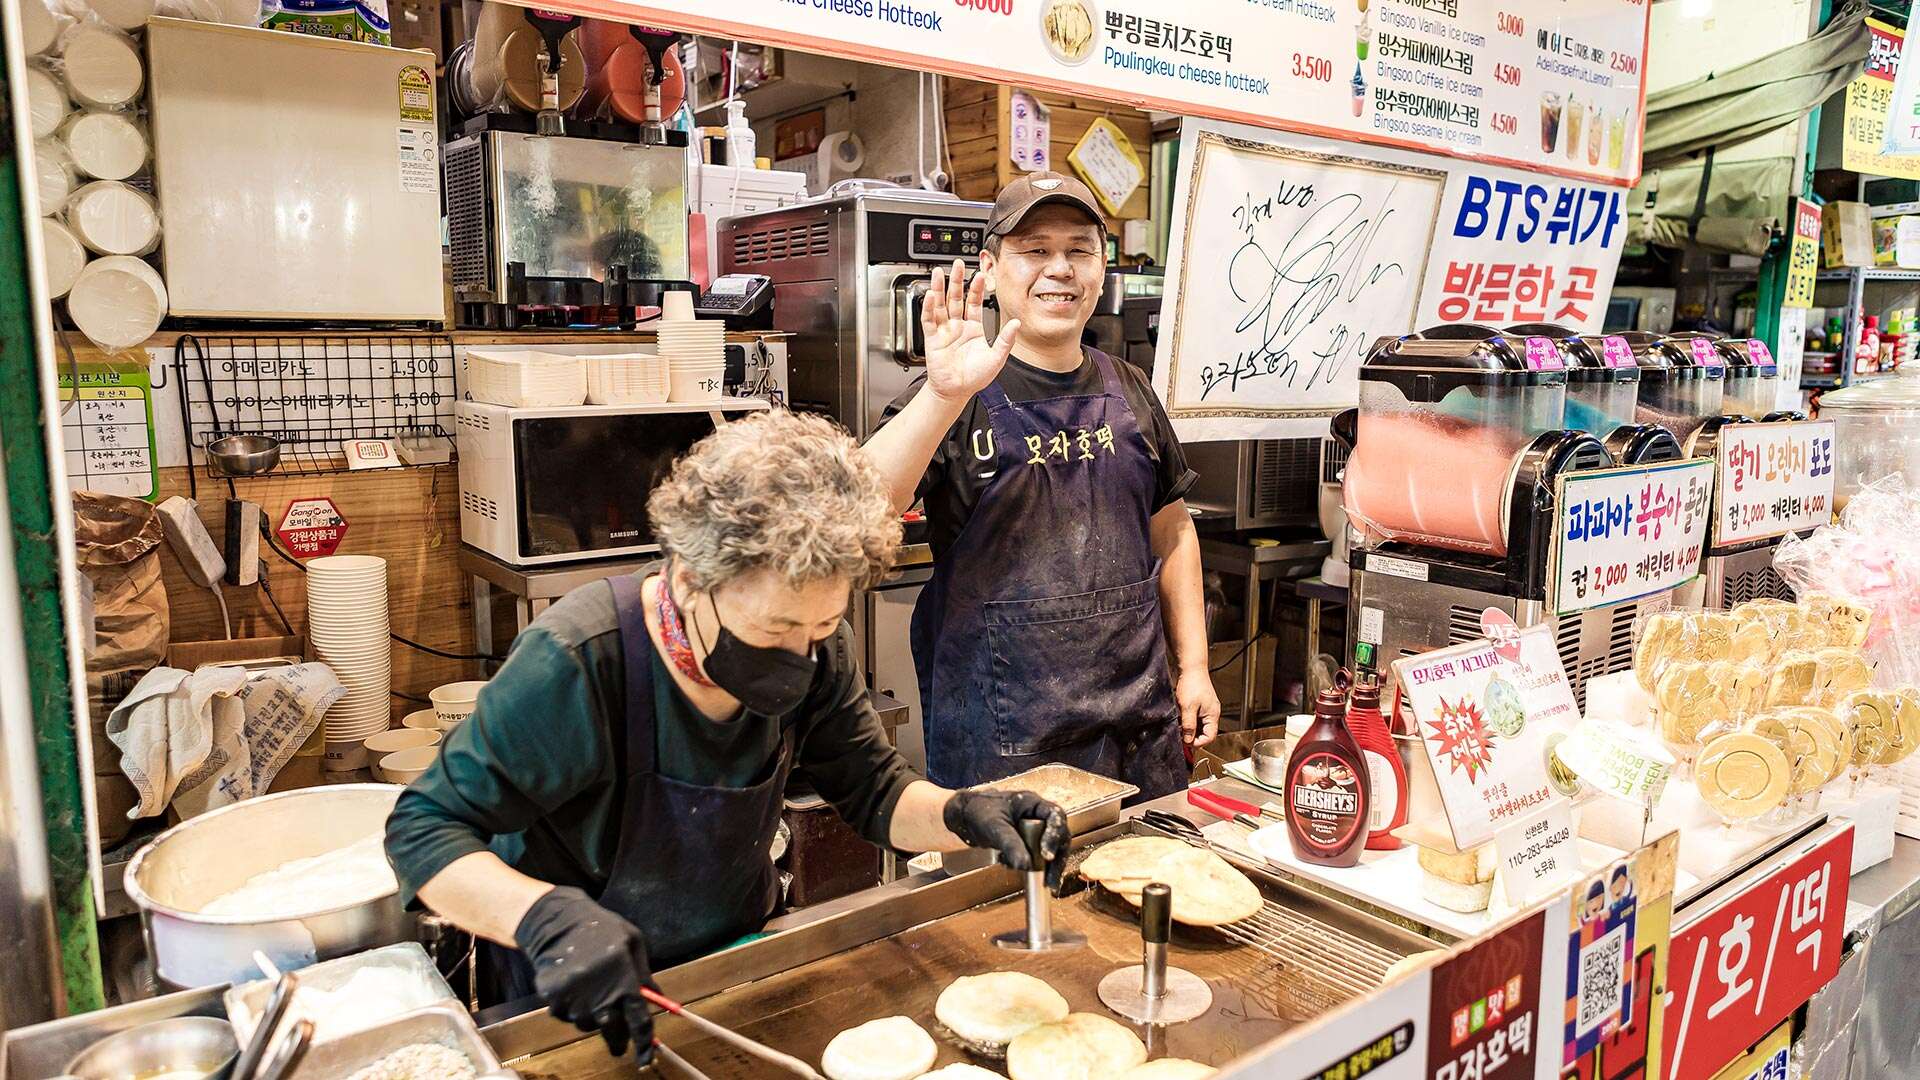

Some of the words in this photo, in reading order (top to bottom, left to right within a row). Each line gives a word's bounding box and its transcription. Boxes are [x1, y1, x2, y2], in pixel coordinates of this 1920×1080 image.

[878, 2, 942, 32] Hotteok
[1104, 9, 1232, 63] 뿌링클치즈호떡
[1104, 45, 1176, 78] Ppulingkeu
[1179, 62, 1221, 86] cheese
[1225, 70, 1270, 96] hotteok
[1378, 31, 1473, 75] 빙수커피아이스크림
[1375, 86, 1480, 128] 빙수흑임자아이스크림
[1438, 261, 1556, 322] 방문한
[1554, 266, 1598, 323] 곳
[221, 360, 316, 377] 아메리카노
[391, 359, 440, 378] 1,500
[1023, 423, 1116, 465] 모자호떡
[1728, 439, 1760, 492] 딸기
[1765, 435, 1806, 483] 오렌지
[1810, 438, 1831, 478] 포도
[1567, 493, 1633, 542] 파파야
[1635, 482, 1682, 542] 복숭아
[1684, 476, 1708, 534] 콜라
[1728, 501, 1739, 531] 컵
[1742, 503, 1765, 530] 2,000
[1771, 495, 1802, 521] 캐릭터
[290, 529, 338, 543] 강원상품권
[610, 530, 639, 539] SAMSUNG
[1571, 565, 1588, 599] 컵
[1594, 563, 1628, 597] 2,000
[1636, 549, 1675, 582] 캐릭터
[1412, 661, 1456, 686] 모자호떡
[1297, 786, 1356, 812] HERSHEY'S
[1311, 810, 1338, 821] SYRUP
